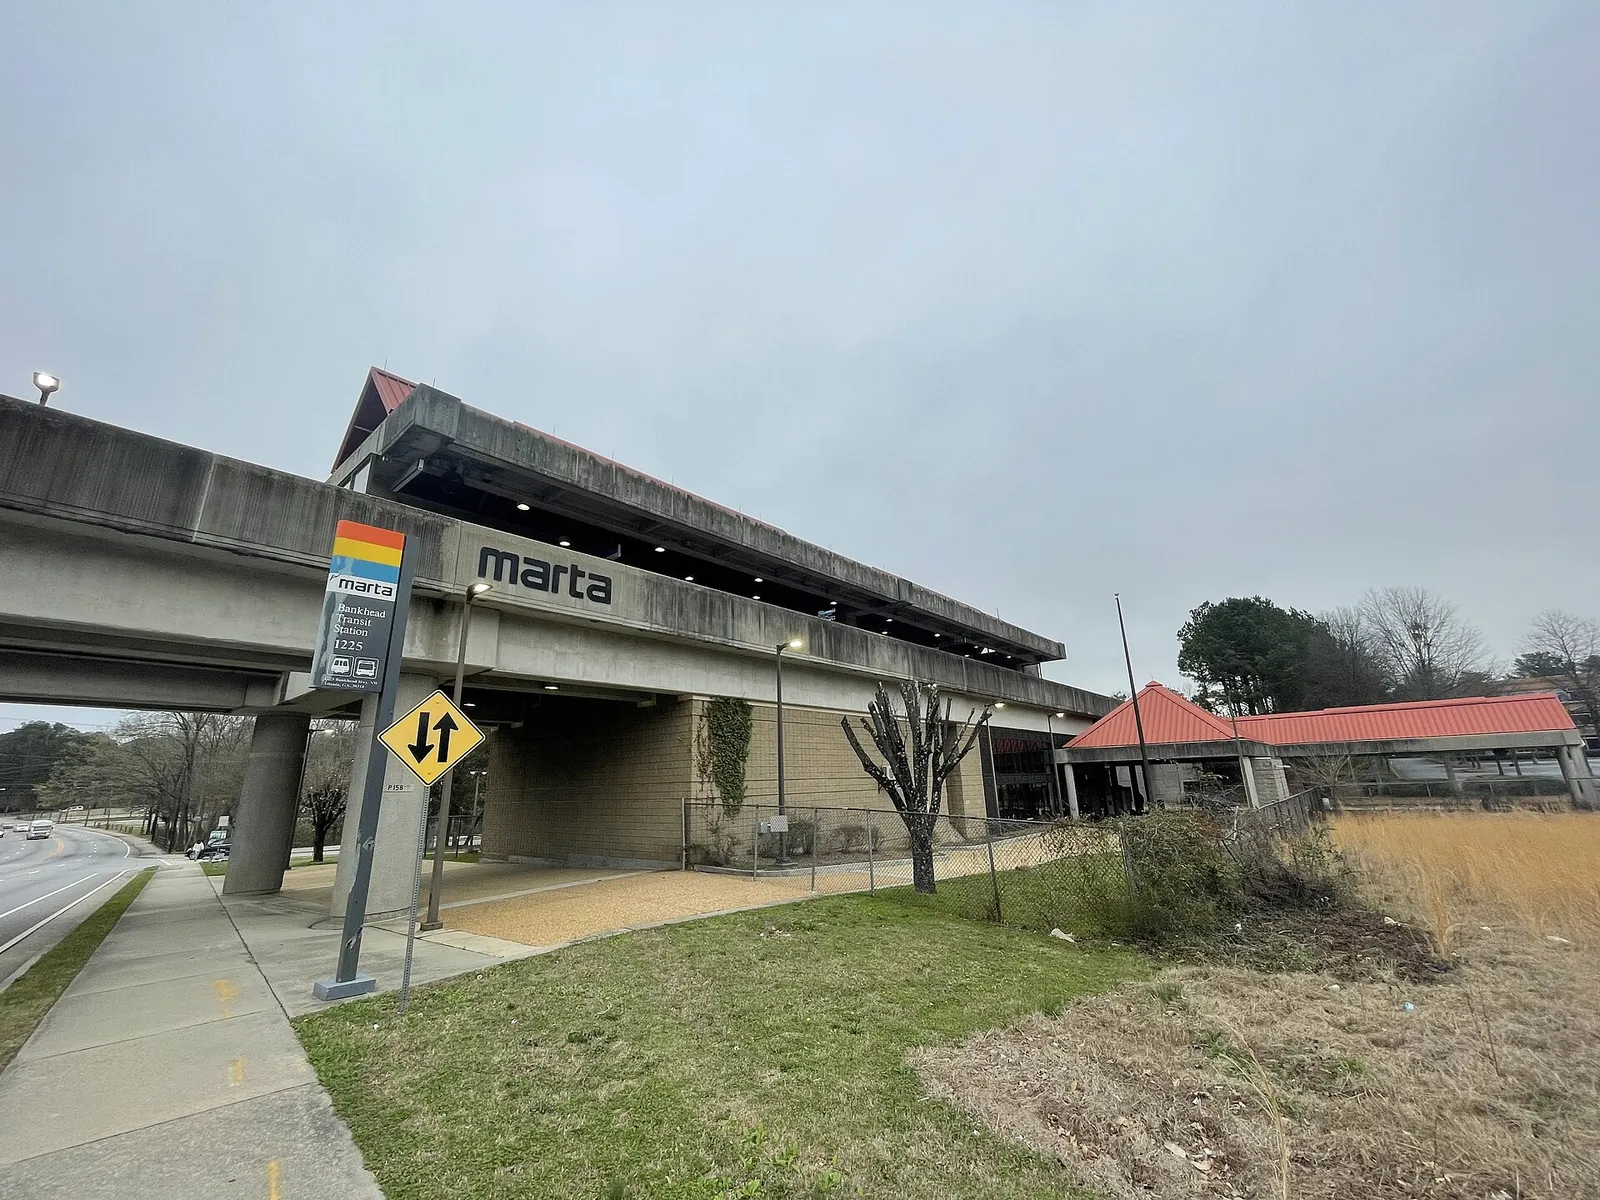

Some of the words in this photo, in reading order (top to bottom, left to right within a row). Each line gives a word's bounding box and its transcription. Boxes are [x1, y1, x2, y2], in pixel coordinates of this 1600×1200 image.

[478, 547, 612, 605] marta
[338, 578, 393, 597] marta
[338, 603, 386, 618] Bankhead
[336, 613, 372, 627] Transit
[333, 623, 368, 637] Station
[334, 639, 364, 651] 1225
